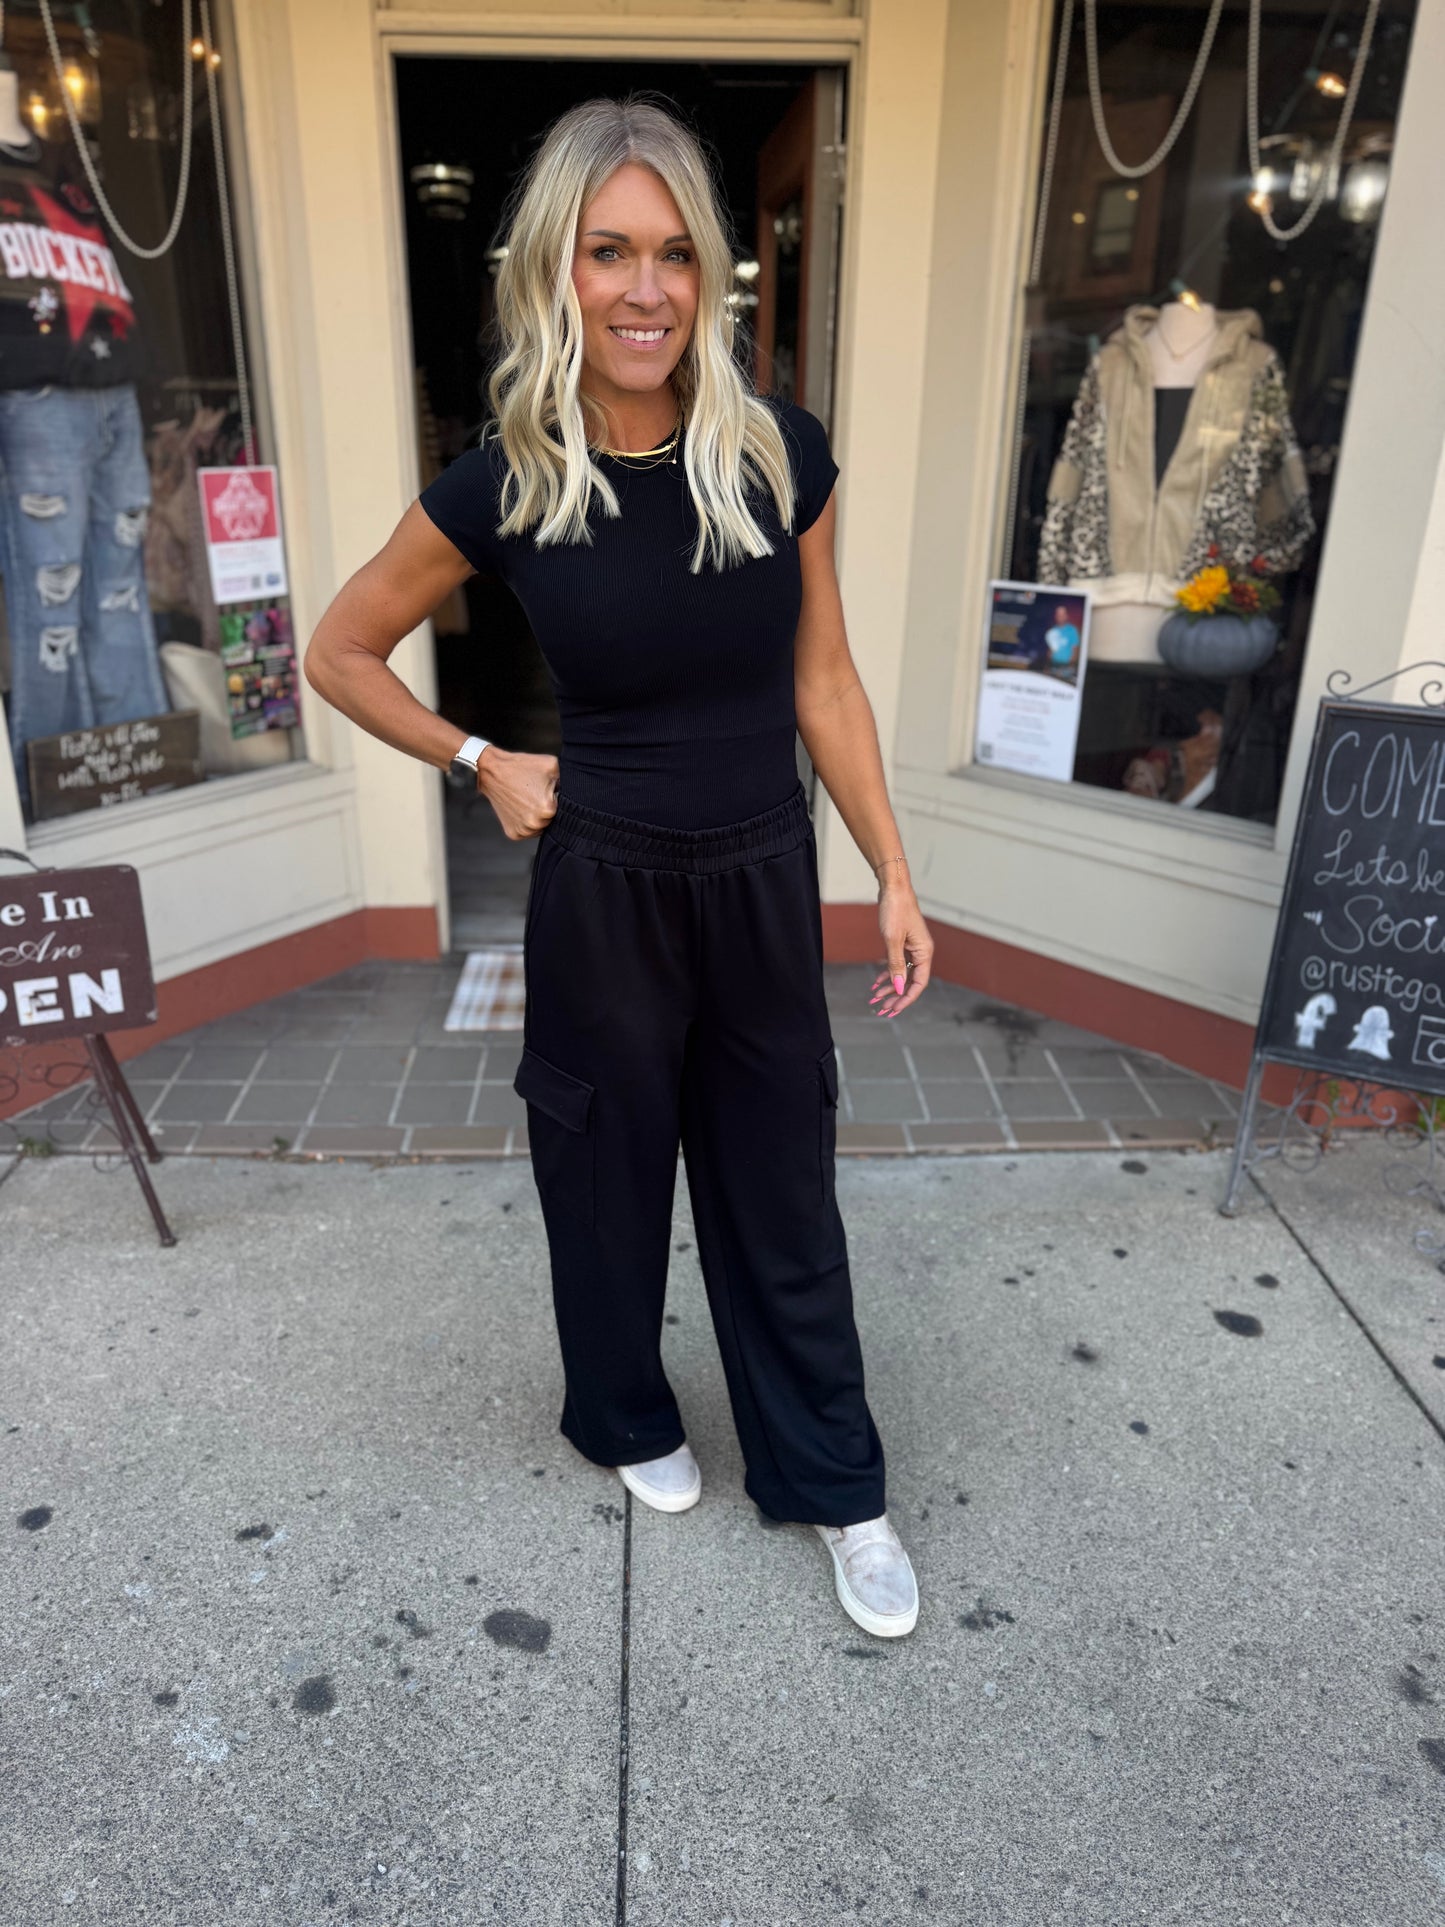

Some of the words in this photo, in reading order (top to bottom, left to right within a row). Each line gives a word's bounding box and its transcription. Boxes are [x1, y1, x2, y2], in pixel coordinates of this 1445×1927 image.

[1323, 731, 1445, 826] COME
[1410, 848, 1445, 896] be
[38, 890, 94, 923] In
[1320, 894, 1445, 953] Soci
[0, 930, 82, 967] Are
